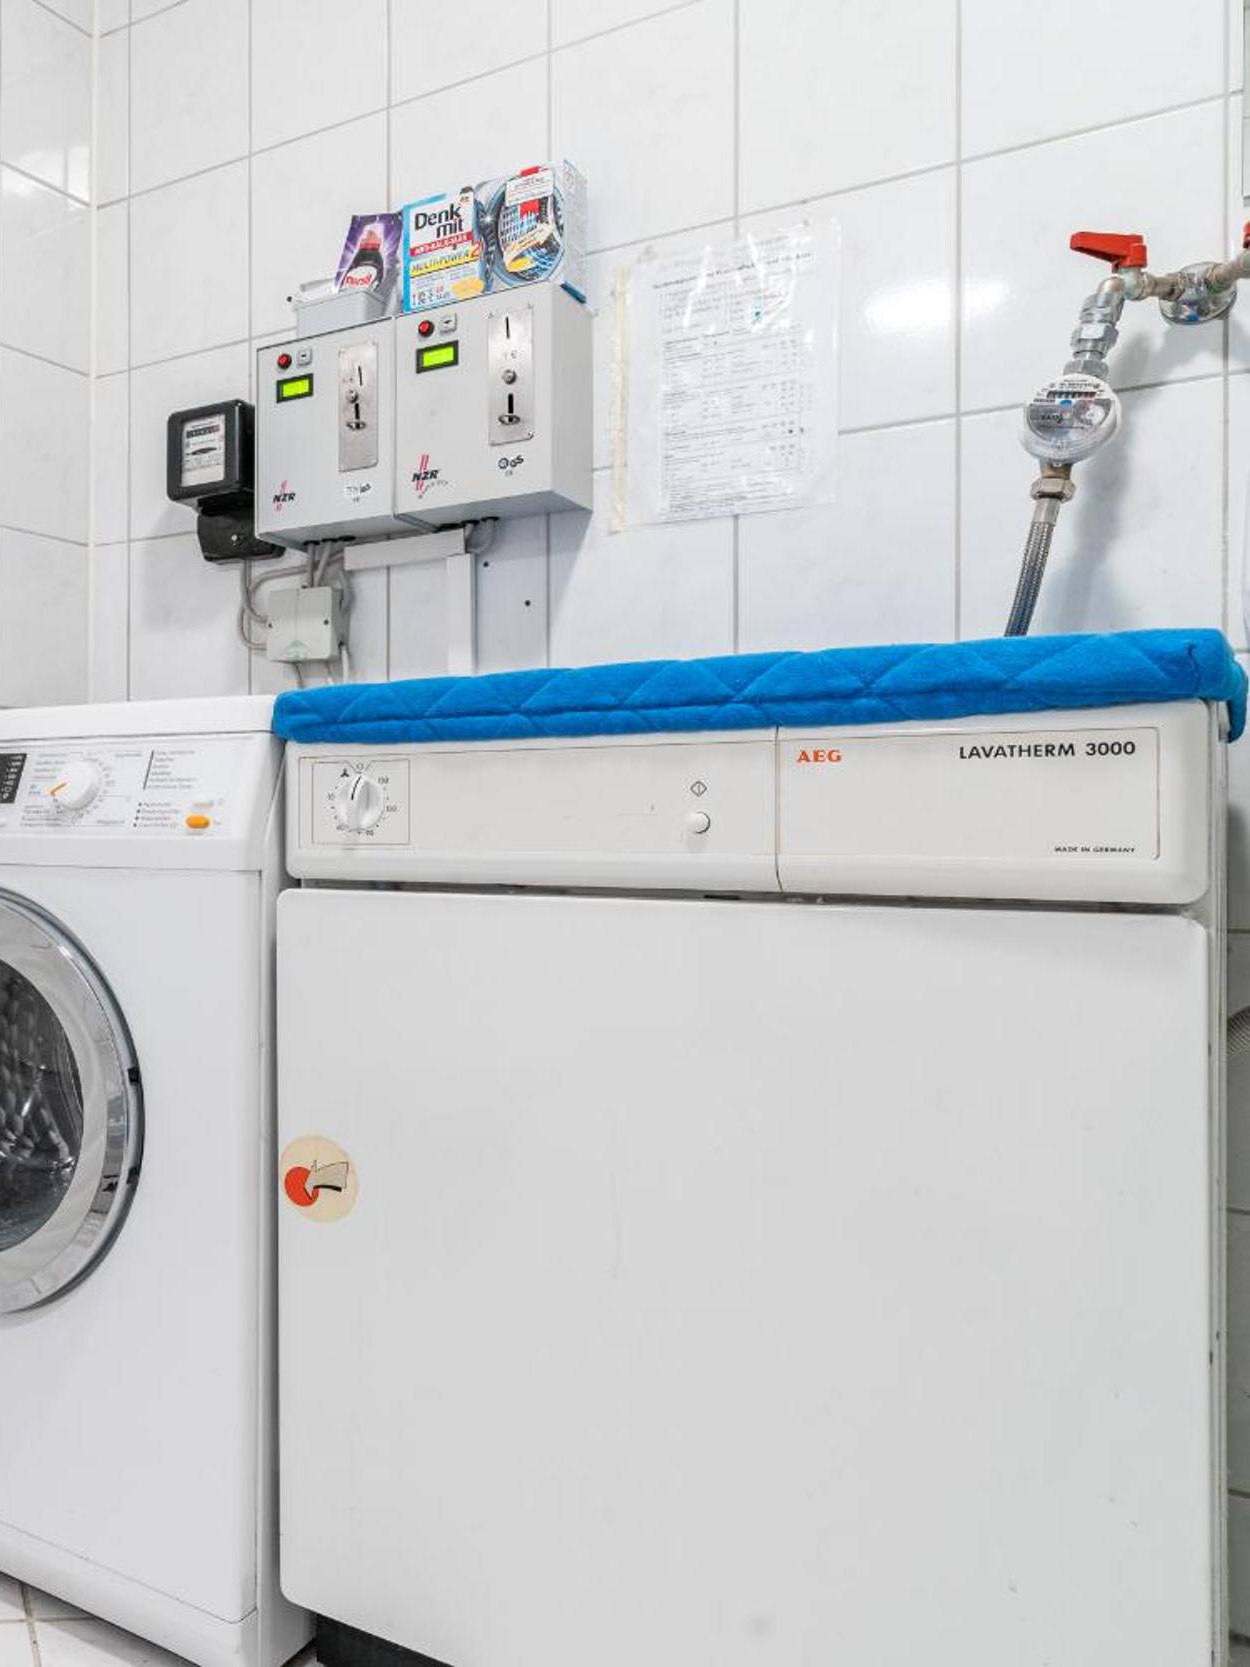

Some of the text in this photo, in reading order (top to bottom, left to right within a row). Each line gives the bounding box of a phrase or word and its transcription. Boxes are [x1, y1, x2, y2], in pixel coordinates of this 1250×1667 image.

[415, 204, 461, 231] Denk
[436, 219, 463, 238] mit
[411, 470, 439, 482] NZR
[272, 492, 296, 503] NZR
[797, 750, 842, 763] AEG
[959, 741, 1136, 760] LAVATHERM 3000
